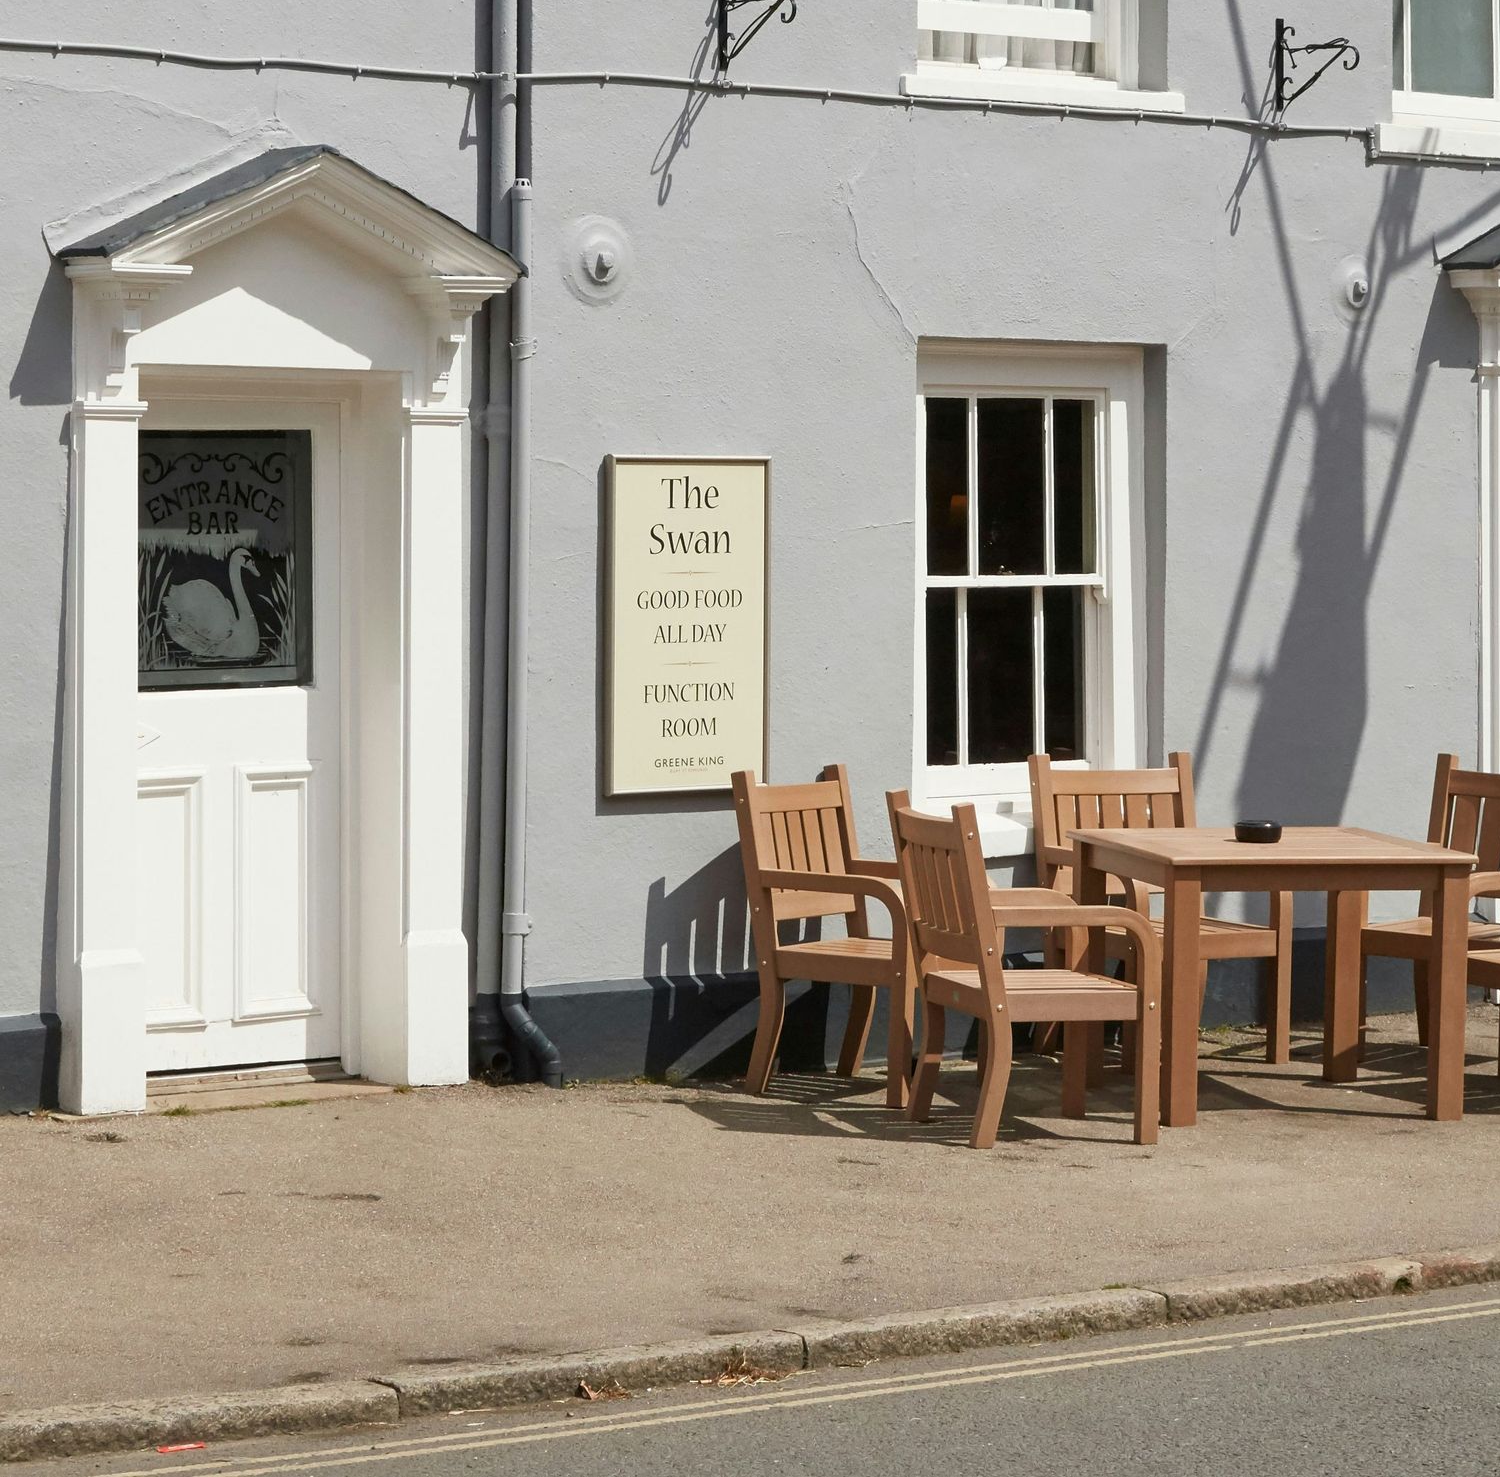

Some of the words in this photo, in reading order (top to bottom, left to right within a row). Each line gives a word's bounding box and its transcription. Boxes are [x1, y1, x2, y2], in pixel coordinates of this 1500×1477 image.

[145, 479, 286, 524] ENTRANCE
[661, 475, 720, 510] The
[187, 511, 240, 535] BAR
[649, 523, 732, 555] Swan
[637, 589, 690, 610] GOOD
[694, 588, 743, 609] FOOD
[653, 625, 688, 644] ALL
[692, 623, 727, 643] DAY
[644, 682, 735, 704] FUNCTION
[661, 717, 717, 738] ROOM
[654, 757, 695, 768] GREENE
[698, 755, 724, 766] KING
